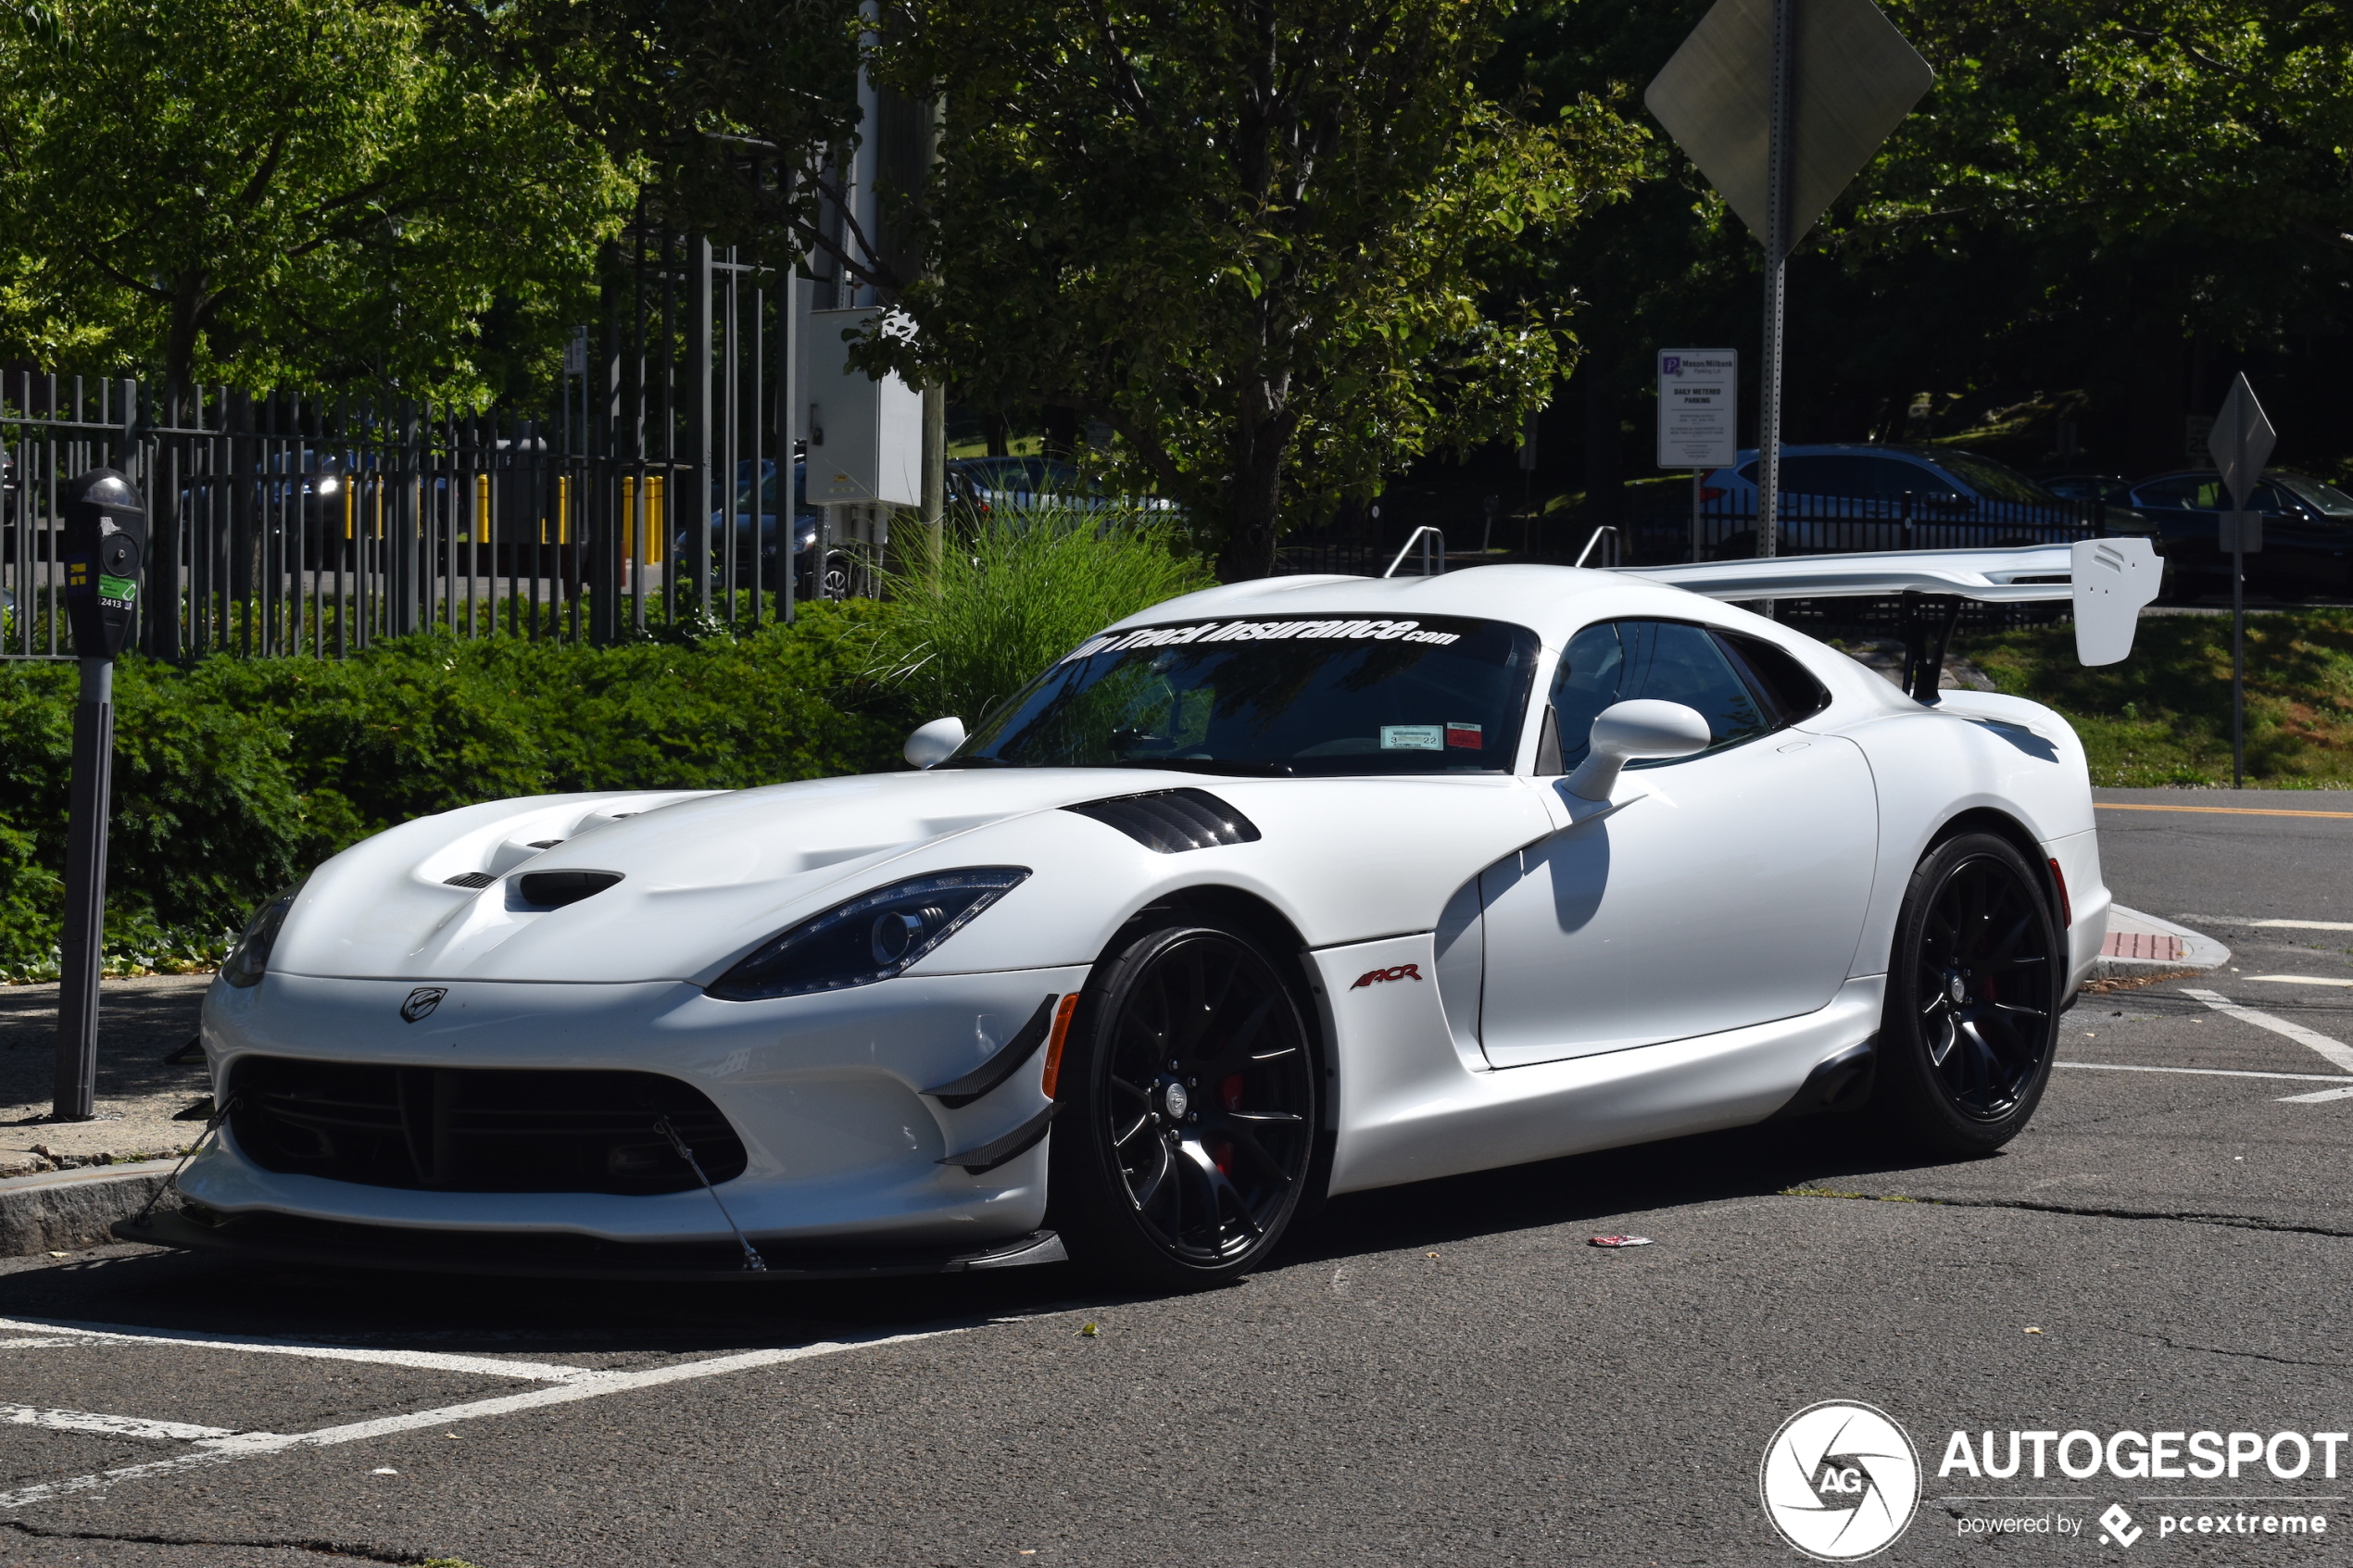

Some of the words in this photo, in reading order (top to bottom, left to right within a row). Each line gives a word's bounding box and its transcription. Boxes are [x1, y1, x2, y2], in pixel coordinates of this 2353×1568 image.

[1681, 359, 1732, 368] Mason/Milbank
[101, 597, 122, 608] 2413
[1101, 622, 1220, 654] Track
[1423, 736, 1437, 745] 22
[1350, 964, 1423, 990] ACR
